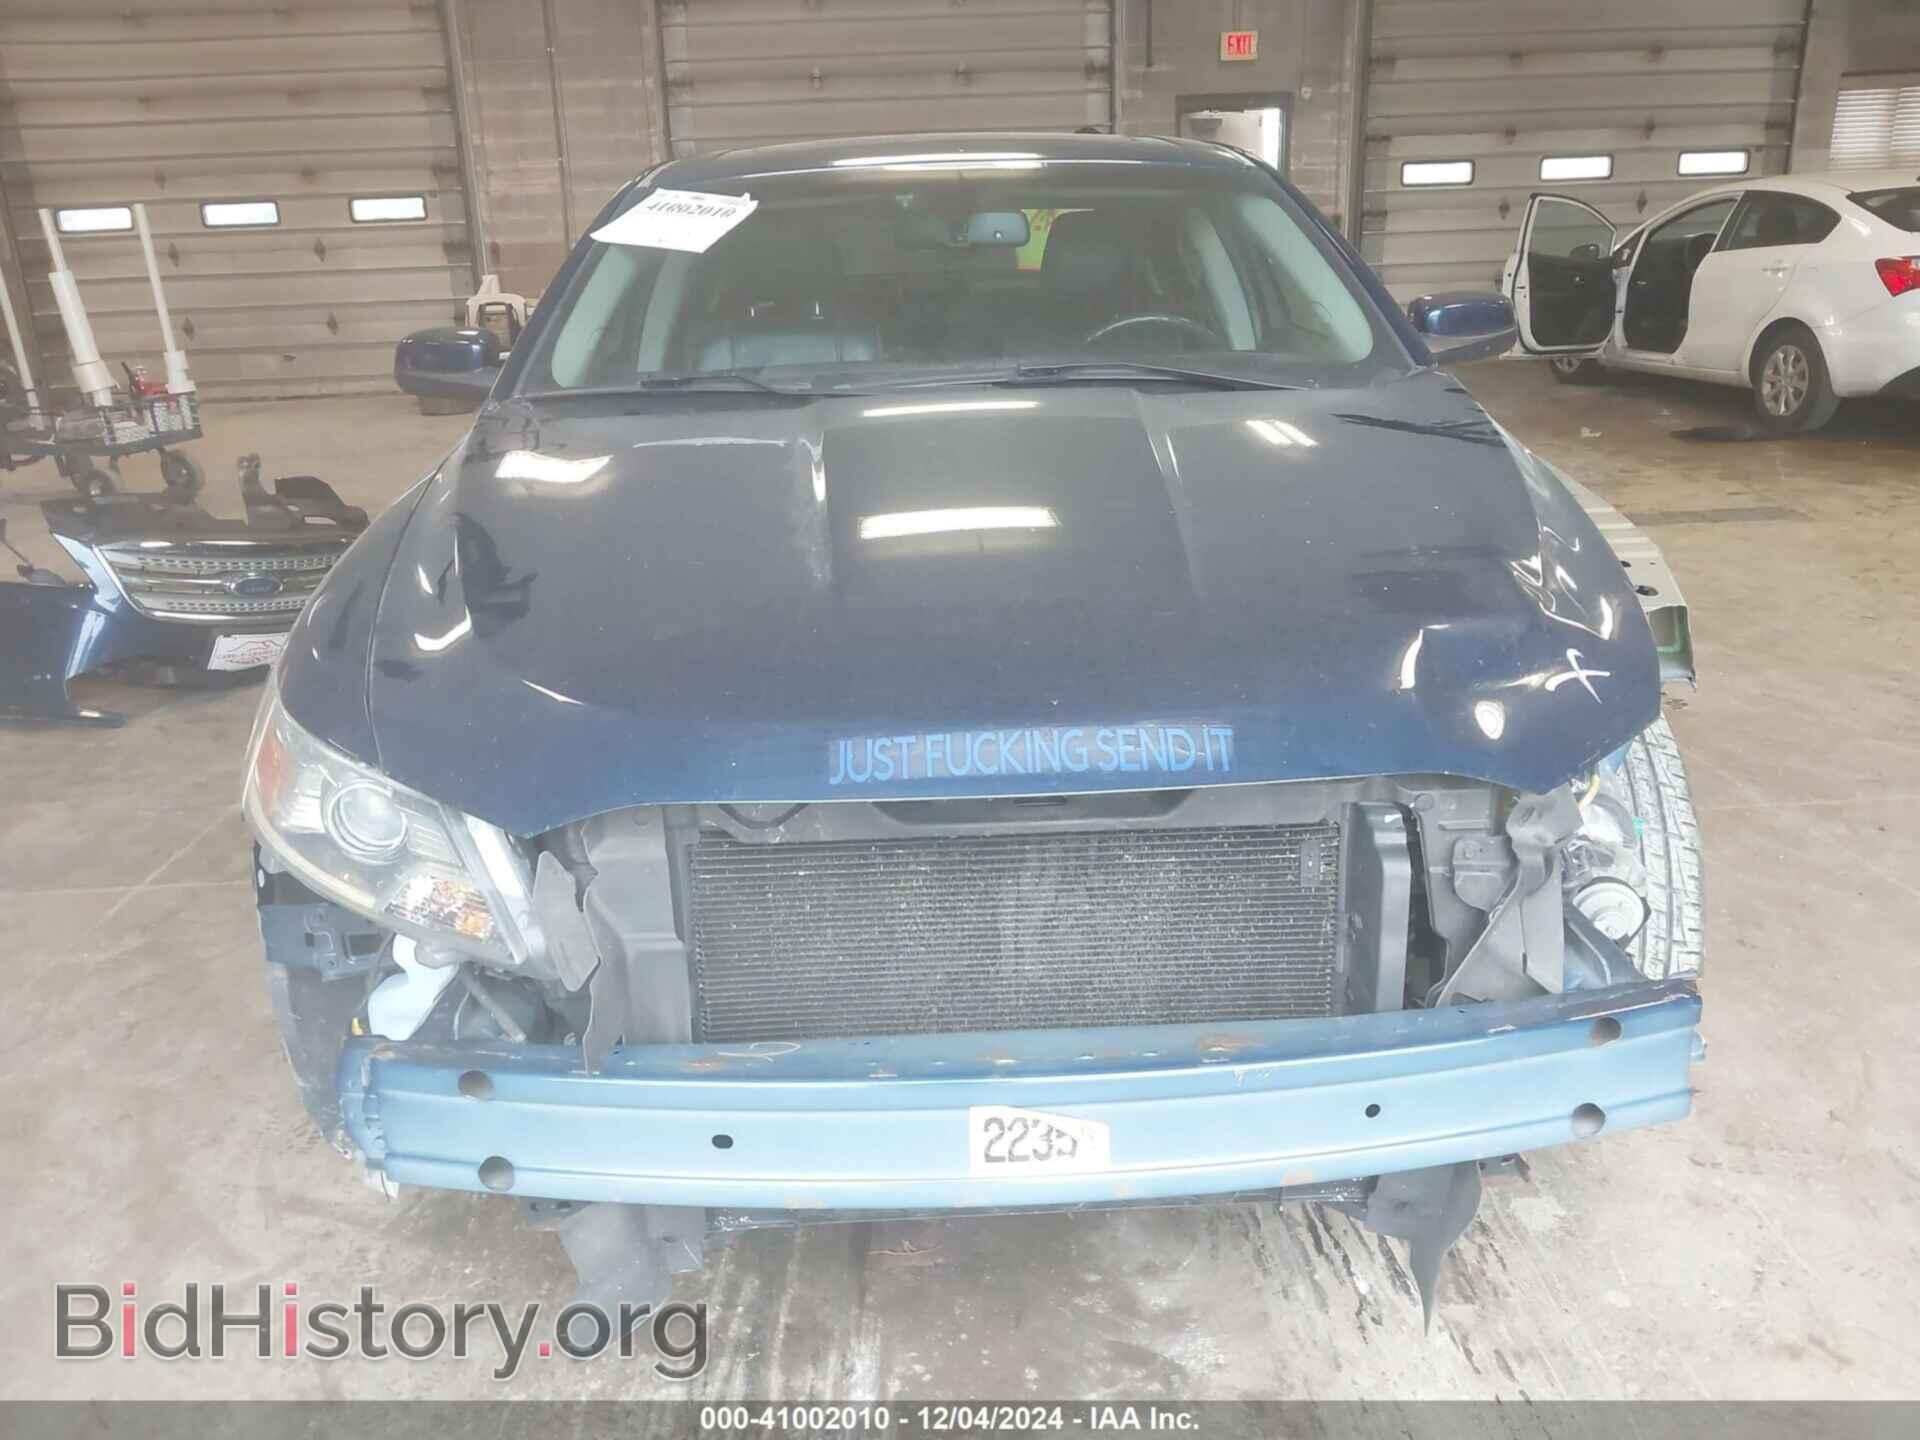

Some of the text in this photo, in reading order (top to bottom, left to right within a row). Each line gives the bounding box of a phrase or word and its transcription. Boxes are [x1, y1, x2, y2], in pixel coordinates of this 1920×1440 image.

[1228, 34, 1252, 55] EXIT
[829, 725, 1233, 785] JUST FUCKING SEND IT
